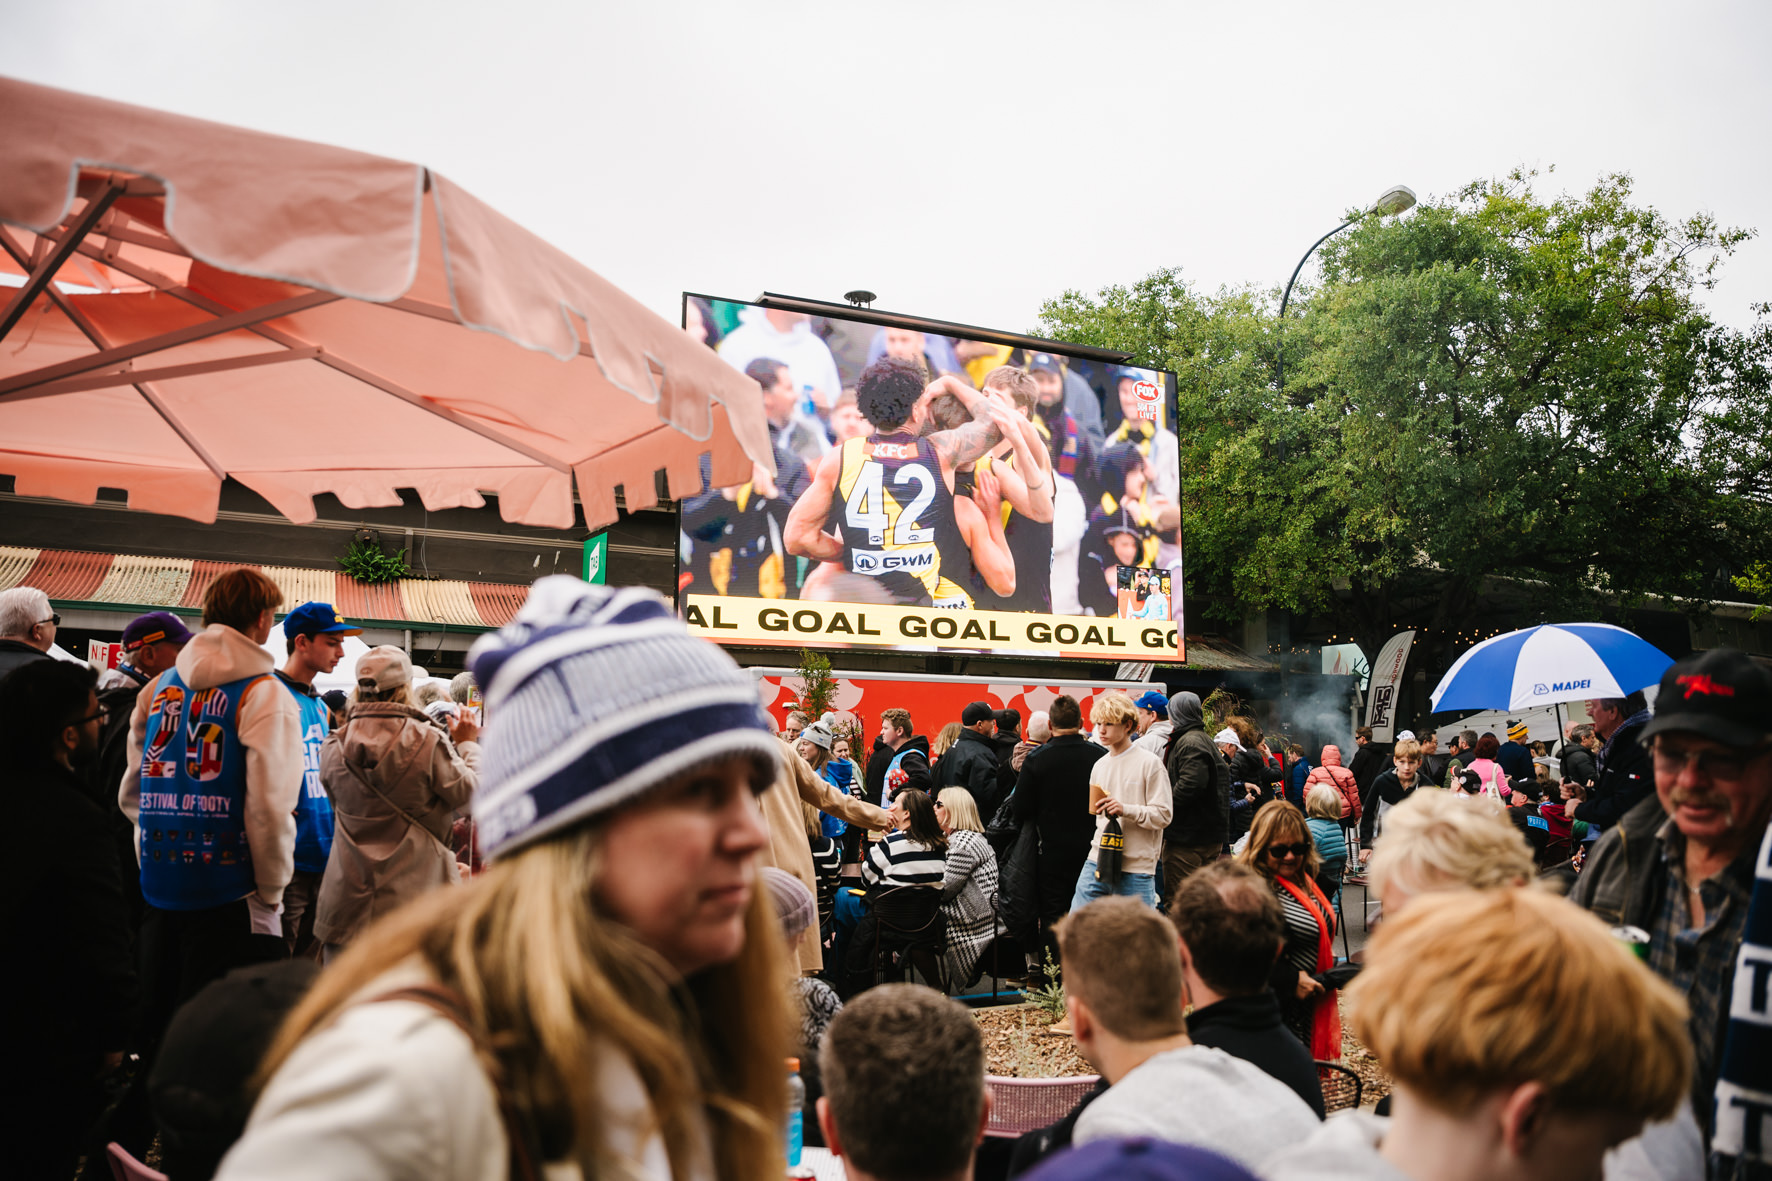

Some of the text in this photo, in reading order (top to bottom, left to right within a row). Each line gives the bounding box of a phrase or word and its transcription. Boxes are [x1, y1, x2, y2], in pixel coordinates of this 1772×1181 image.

[1136, 384, 1156, 398] FOX
[1139, 410, 1154, 420] LIVE
[872, 443, 908, 459] KFC
[845, 460, 936, 545] 42
[883, 553, 932, 568] GWM
[687, 604, 738, 630] AL
[758, 608, 881, 636] GOAL
[899, 615, 1011, 642] GOAL
[1026, 622, 1126, 647] GOAL
[1391, 648, 1404, 684] NORWOOD
[1552, 679, 1591, 692] MAPEI
[1371, 687, 1393, 727] F45
[141, 685, 229, 782] 26
[139, 792, 178, 810] ESTIVAL
[182, 794, 196, 811] OF
